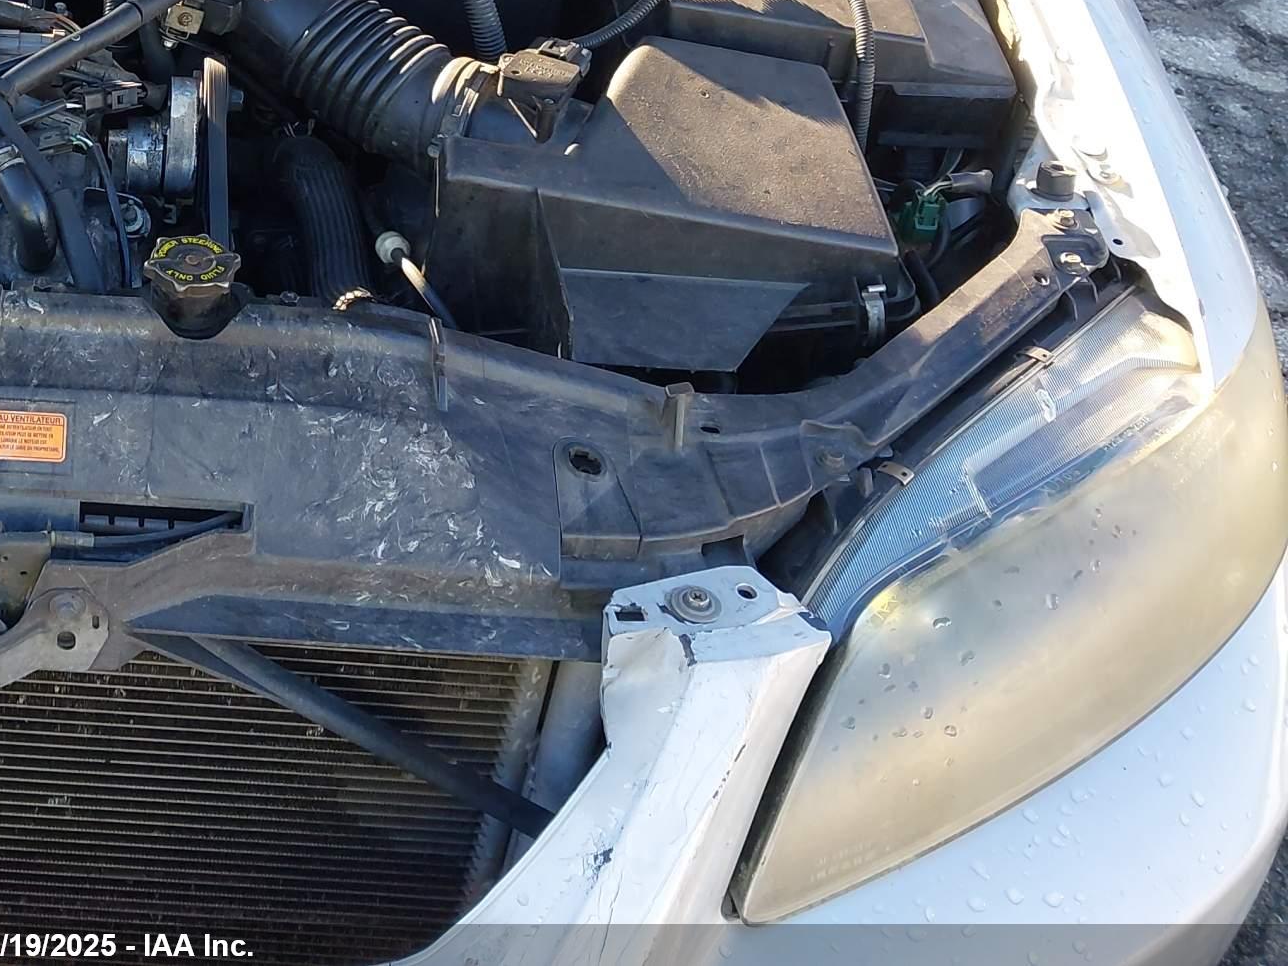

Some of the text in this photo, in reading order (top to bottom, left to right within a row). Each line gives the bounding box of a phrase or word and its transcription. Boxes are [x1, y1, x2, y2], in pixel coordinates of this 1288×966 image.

[180, 237, 223, 254] STEERING
[165, 265, 225, 281] FLUID ONLY
[10, 415, 62, 425] VENTILATEUR
